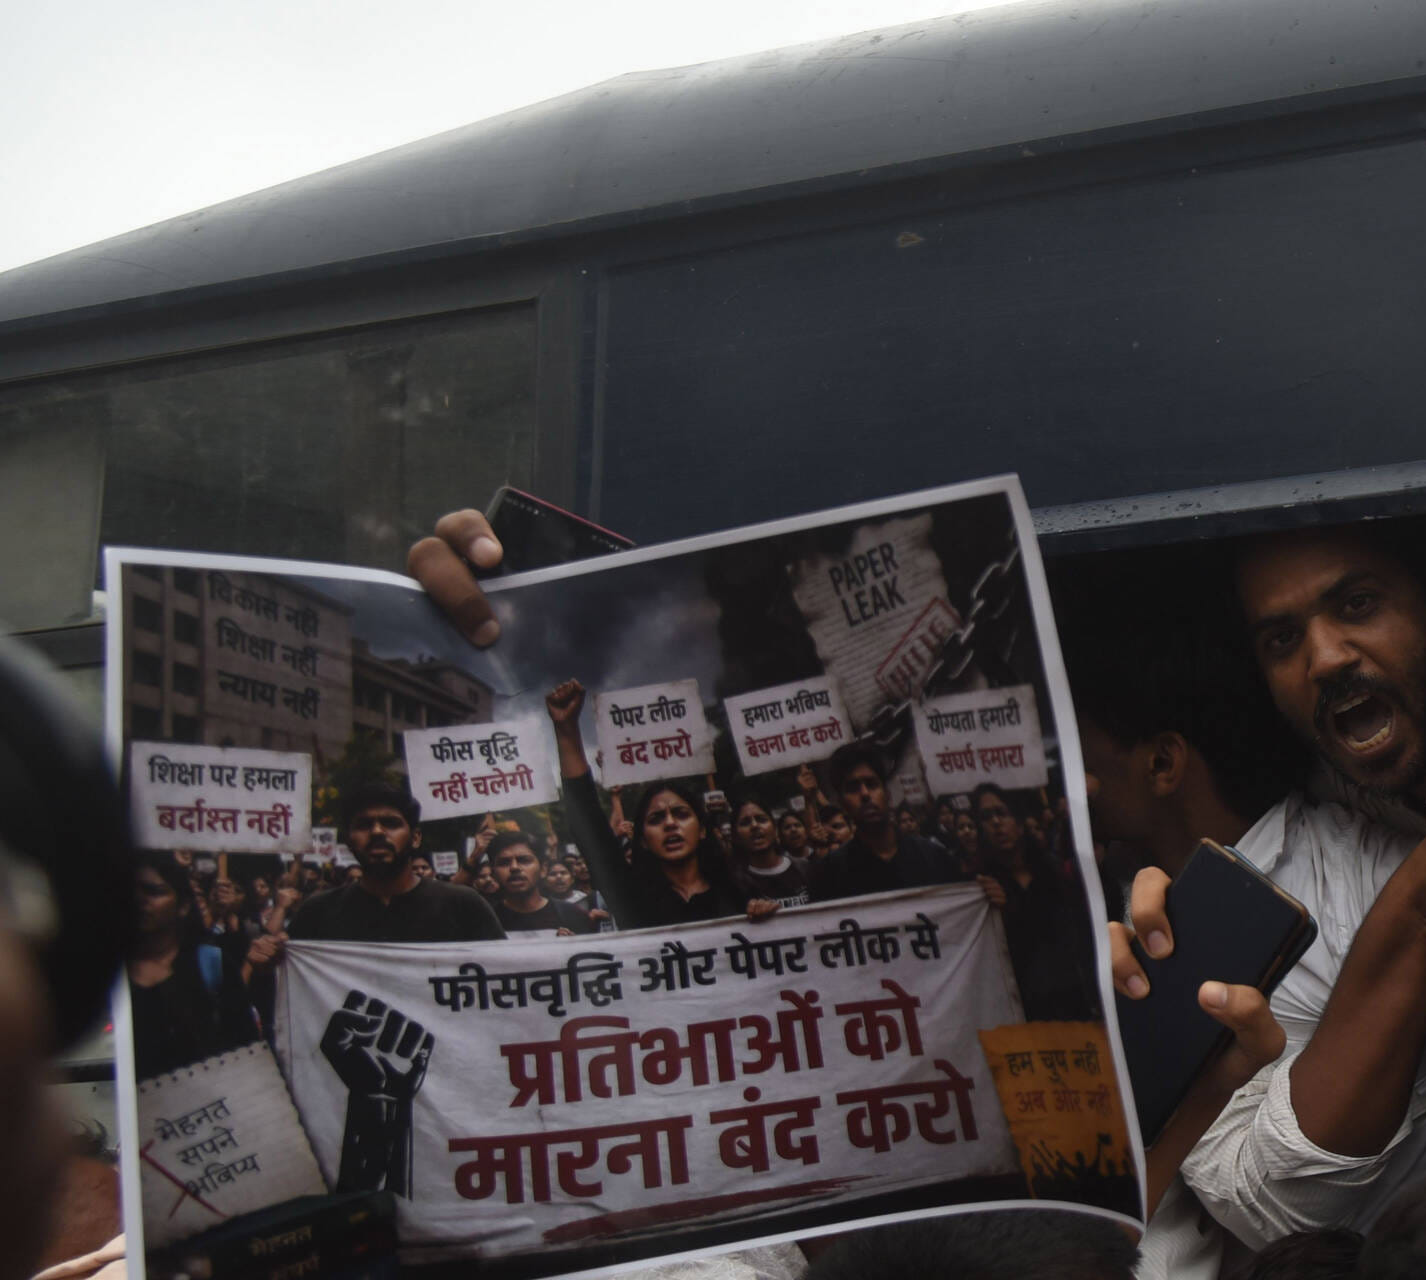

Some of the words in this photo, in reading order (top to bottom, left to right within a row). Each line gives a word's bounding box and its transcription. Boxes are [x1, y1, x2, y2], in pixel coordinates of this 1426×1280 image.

[828, 543, 899, 596] PAPER
[207, 570, 279, 622] विकास
[841, 575, 906, 627] LEAK
[216, 617, 275, 662] शिक्षा
[216, 670, 276, 708] न्याय
[609, 704, 646, 728] पेपर
[647, 696, 686, 722] लीक
[742, 700, 784, 728] हमारा
[927, 708, 976, 735] योग्यता
[978, 698, 1022, 732] हमारी
[431, 737, 474, 762] फीस
[616, 737, 649, 765] बंद
[651, 728, 693, 760] करो
[745, 734, 786, 758] बेचना
[787, 725, 811, 748] बंद
[811, 716, 843, 742] करो
[148, 755, 204, 786] शिक्षा
[210, 765, 238, 788] पर
[243, 767, 297, 792] हमला
[978, 744, 1025, 773] हमारा
[429, 772, 469, 803] नहीं
[471, 764, 535, 796] चलेगी
[156, 799, 240, 833] बर्दाश्त
[246, 803, 293, 839] नहीं
[725, 931, 807, 981] पेपर
[814, 918, 900, 969] लीक
[905, 912, 941, 960] से
[500, 990, 825, 1108] प्रतिभाओं
[835, 978, 925, 1061] को
[1005, 1052, 1035, 1077] हम
[1038, 1050, 1069, 1083] चुप
[154, 1097, 232, 1140] मेहनत
[1016, 1090, 1048, 1113] अब
[176, 1126, 240, 1165] सपने
[448, 1115, 694, 1205] मारना
[710, 1086, 822, 1174] बंद
[836, 1059, 979, 1155] करो
